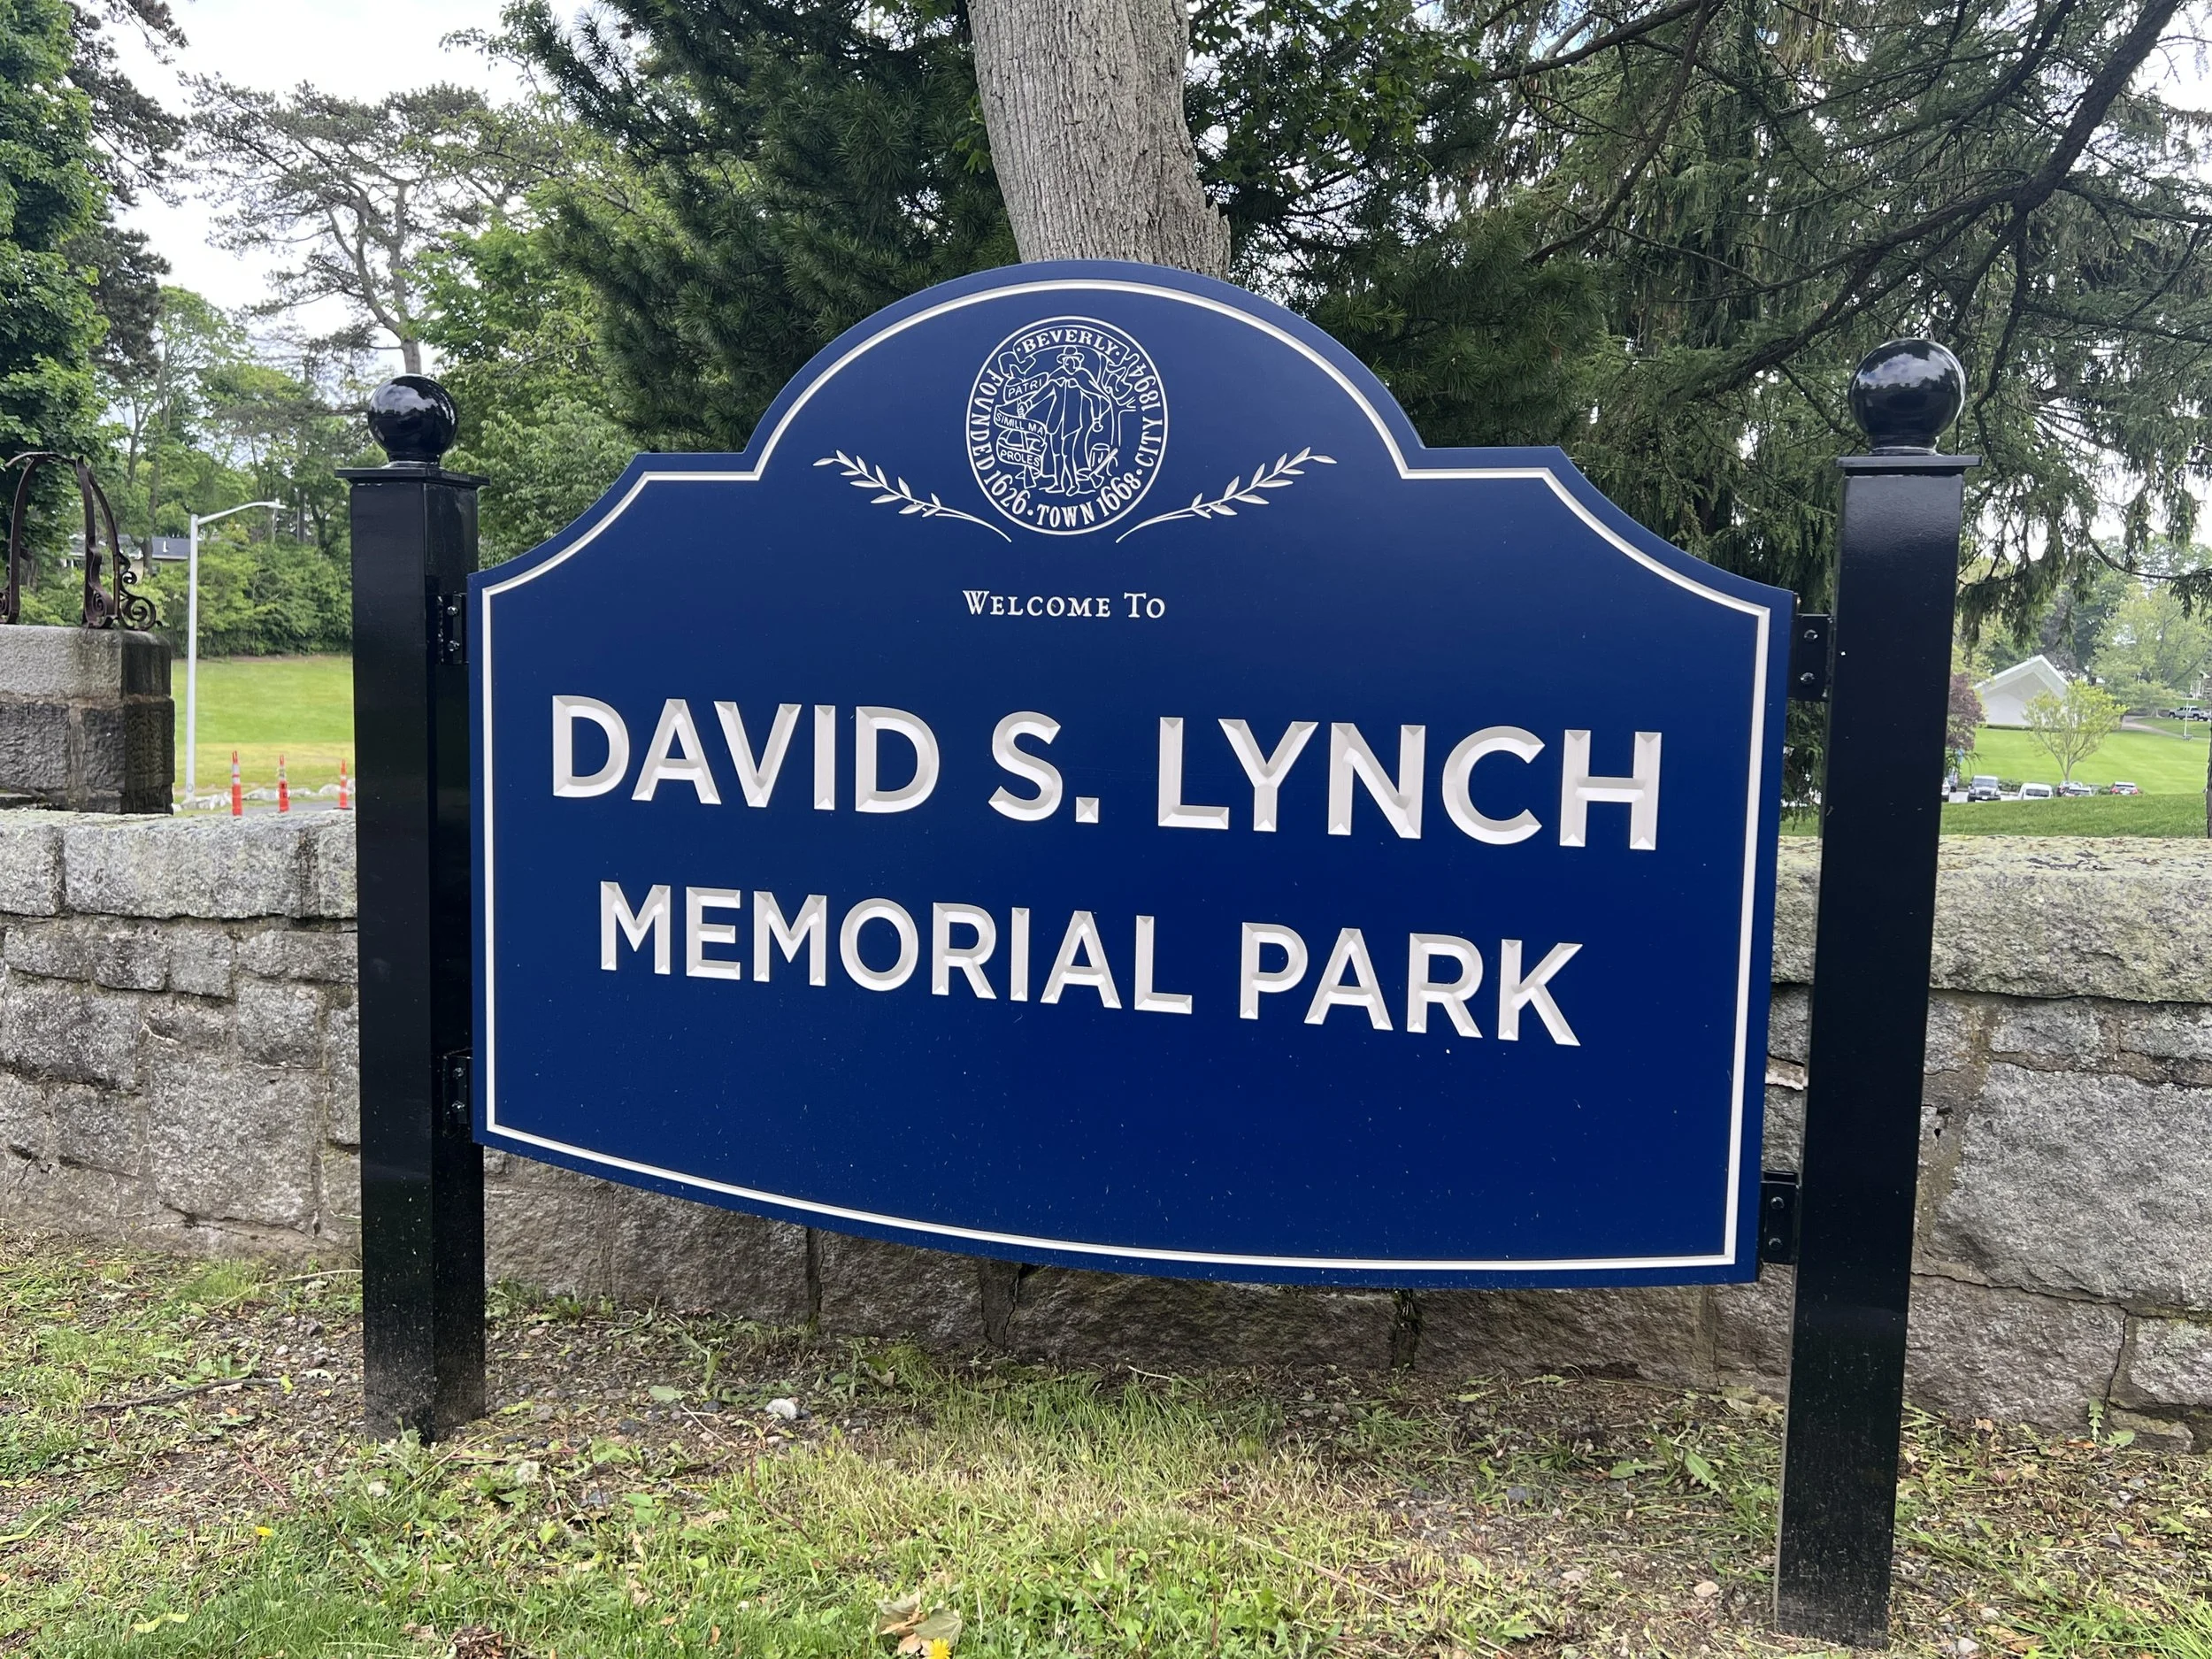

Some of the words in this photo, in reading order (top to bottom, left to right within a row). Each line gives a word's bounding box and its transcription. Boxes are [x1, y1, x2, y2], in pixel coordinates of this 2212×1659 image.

[1021, 329, 1117, 355] BEVERLY
[1008, 378, 1043, 397] PATRI
[1129, 363, 1161, 412] 1894
[1000, 449, 1041, 467] PROLES
[1133, 417, 1164, 468] CITY
[983, 470, 1031, 516] 1626
[1036, 501, 1095, 528] TOWN
[1096, 472, 1141, 517] 1668
[552, 695, 940, 814] DAVID
[987, 710, 1100, 824] S.
[1157, 717, 1662, 851] LYNCH
[600, 881, 1193, 1015] MEMORIAL
[1239, 921, 1583, 1047] PARK
